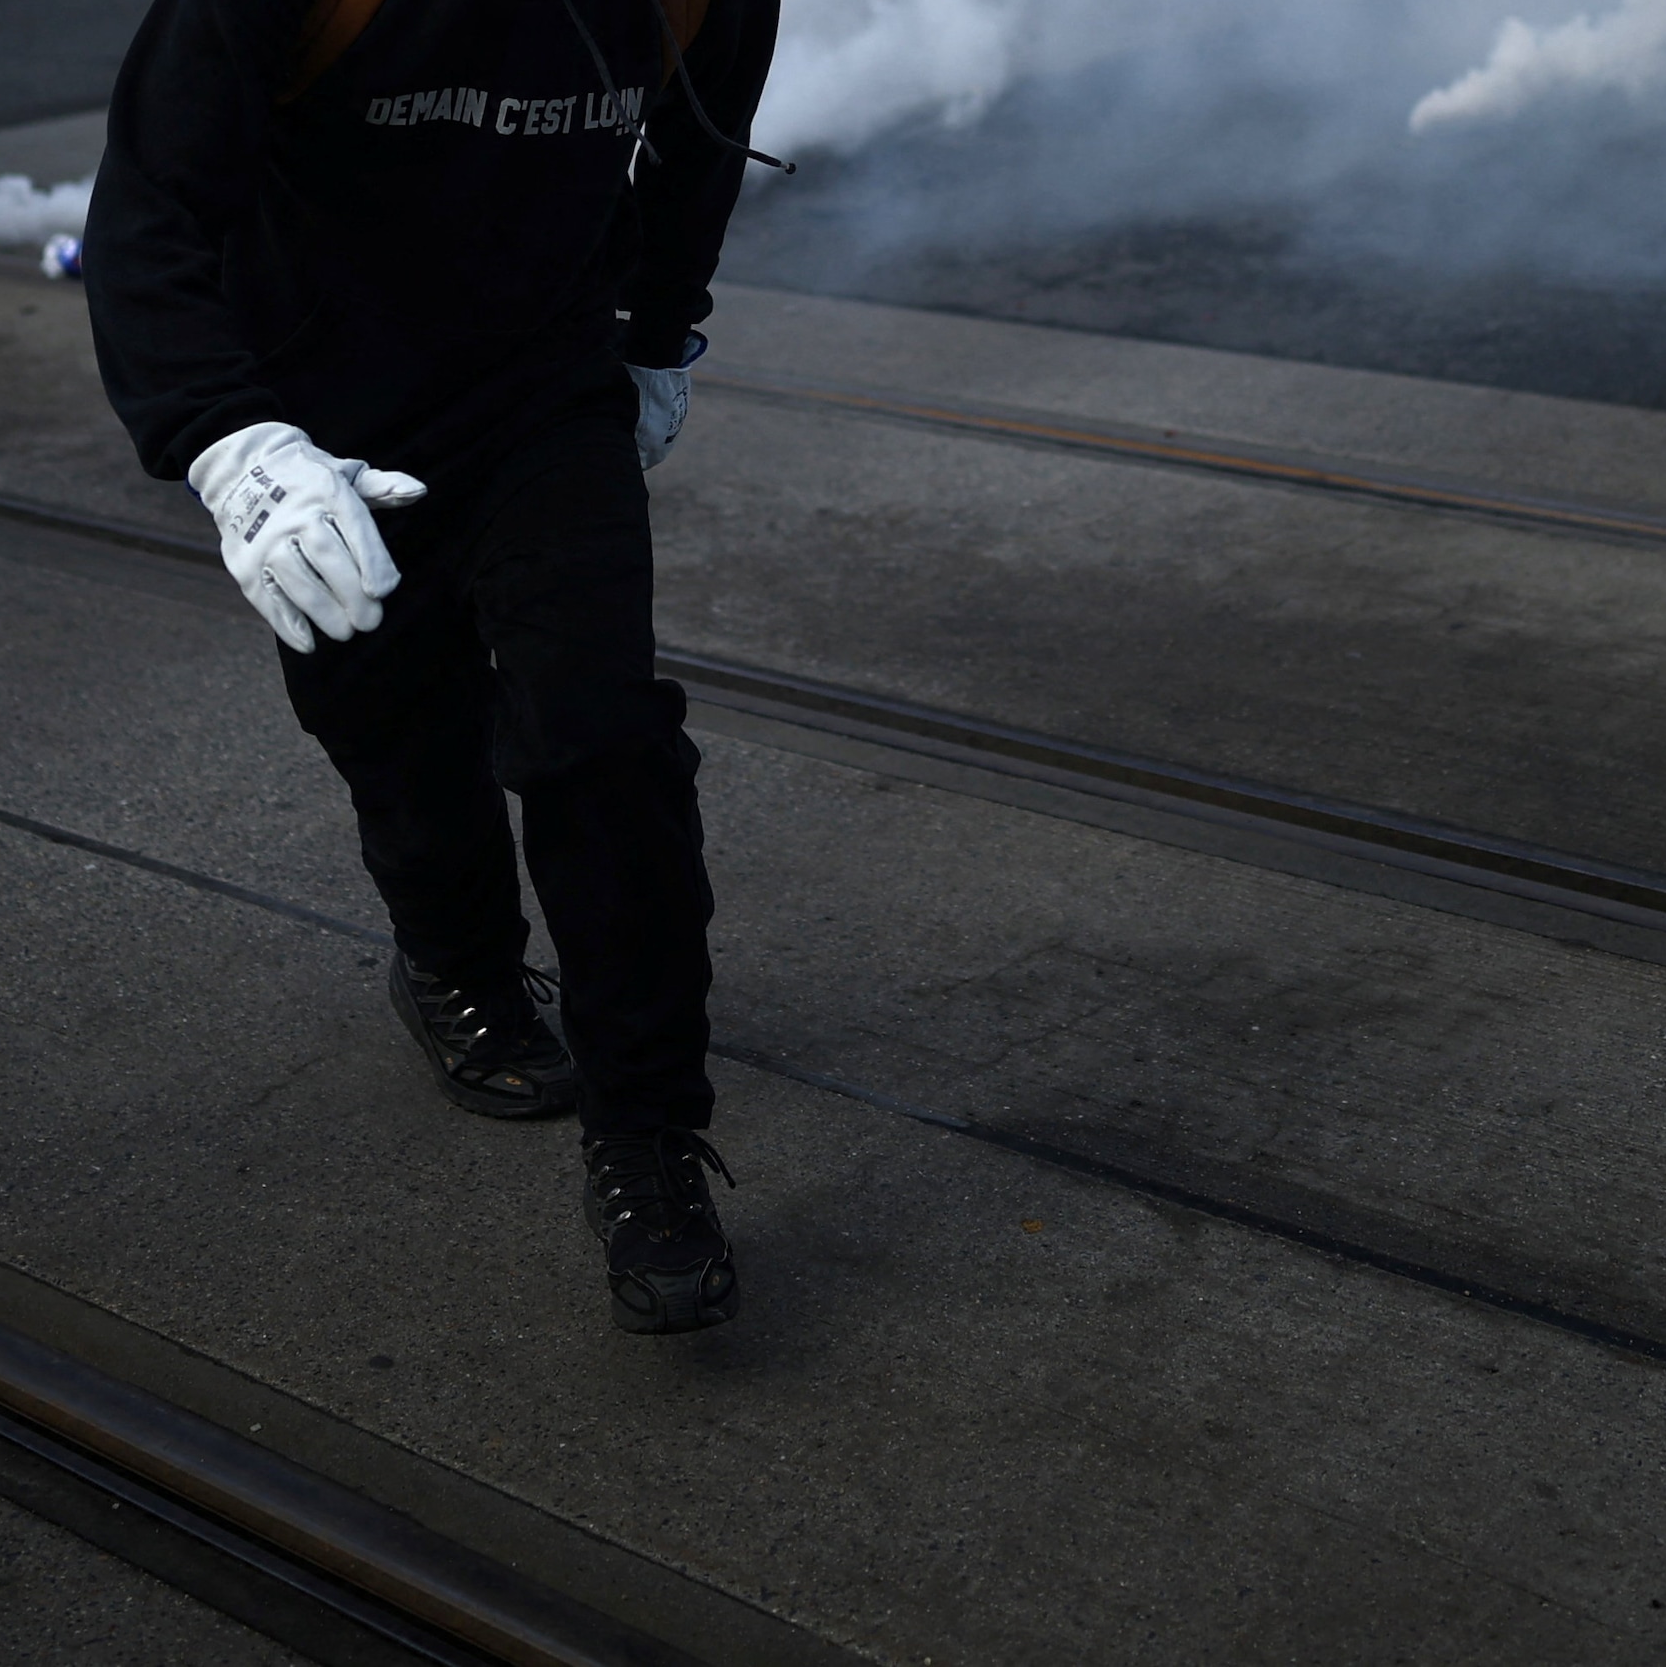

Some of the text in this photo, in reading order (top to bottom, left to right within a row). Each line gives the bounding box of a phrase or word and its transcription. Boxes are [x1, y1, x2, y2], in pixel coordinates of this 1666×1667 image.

[365, 86, 645, 137] DEMAIN C'EST LOIN
